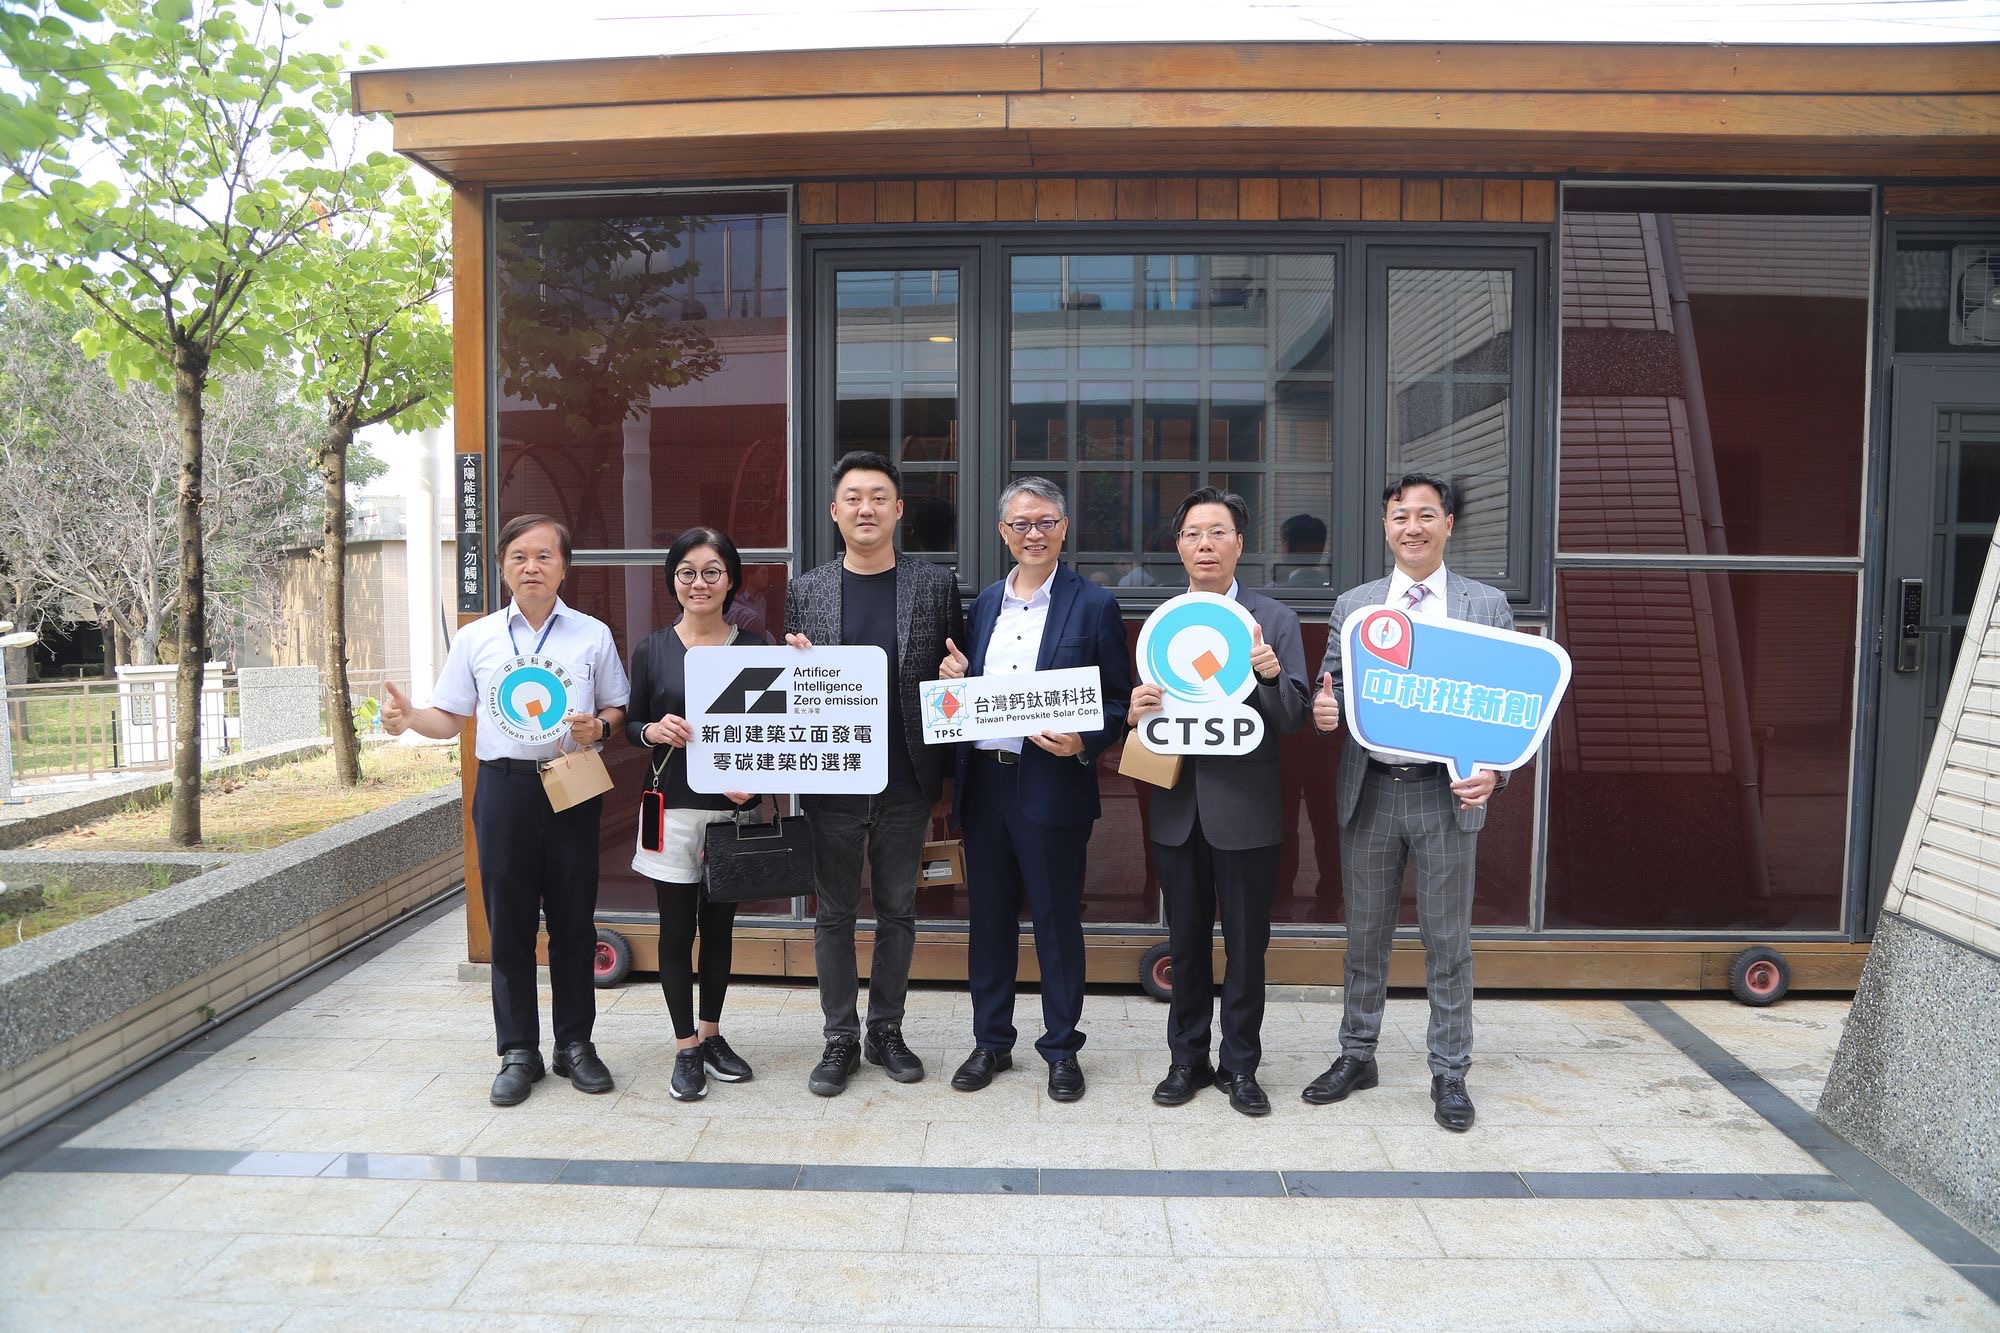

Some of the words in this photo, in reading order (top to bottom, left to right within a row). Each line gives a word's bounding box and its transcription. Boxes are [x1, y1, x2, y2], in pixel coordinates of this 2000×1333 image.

[463, 454, 476, 533] 太陽能板高溫
[793, 667, 841, 678] Artificer
[793, 681, 863, 694] Intelligence
[793, 695, 821, 706] Zero
[825, 695, 878, 706] emission
[974, 686, 1097, 714] 台灣鈣鈦礦科技
[1362, 669, 1543, 730] 中科挺新創
[490, 686, 500, 718] Central
[499, 720, 525, 740] Taiwan
[530, 727, 560, 741] Science
[975, 716, 1004, 725] Taiwan
[1006, 712, 1051, 722] Perovskite
[1053, 709, 1075, 718] Solar
[1077, 707, 1101, 716] Corp.
[702, 724, 872, 744] 新創建築立面發電
[934, 728, 963, 739] TPSC
[1146, 717, 1255, 746] CTSP
[713, 752, 862, 771] 零碳建築的選擇
